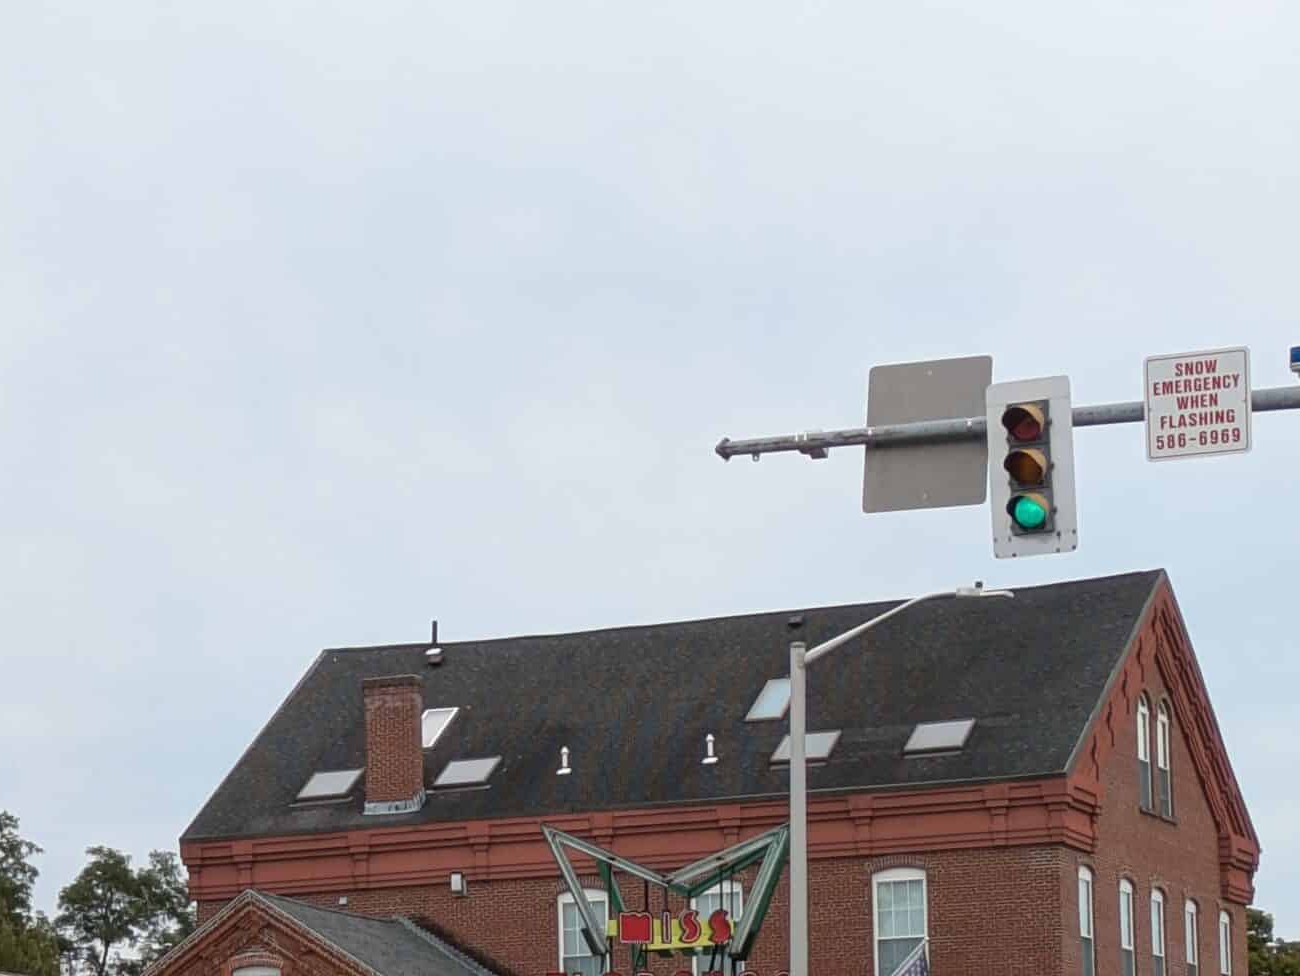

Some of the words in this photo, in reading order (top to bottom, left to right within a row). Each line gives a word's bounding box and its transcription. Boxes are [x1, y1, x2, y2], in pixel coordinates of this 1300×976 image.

[1175, 360, 1217, 377] SNOW
[1153, 374, 1240, 396] EMERGENCY
[1177, 393, 1218, 410] WHEN
[1160, 409, 1236, 430] FLASHING
[1156, 428, 1241, 450] 586-6969
[619, 909, 731, 945] MISS
